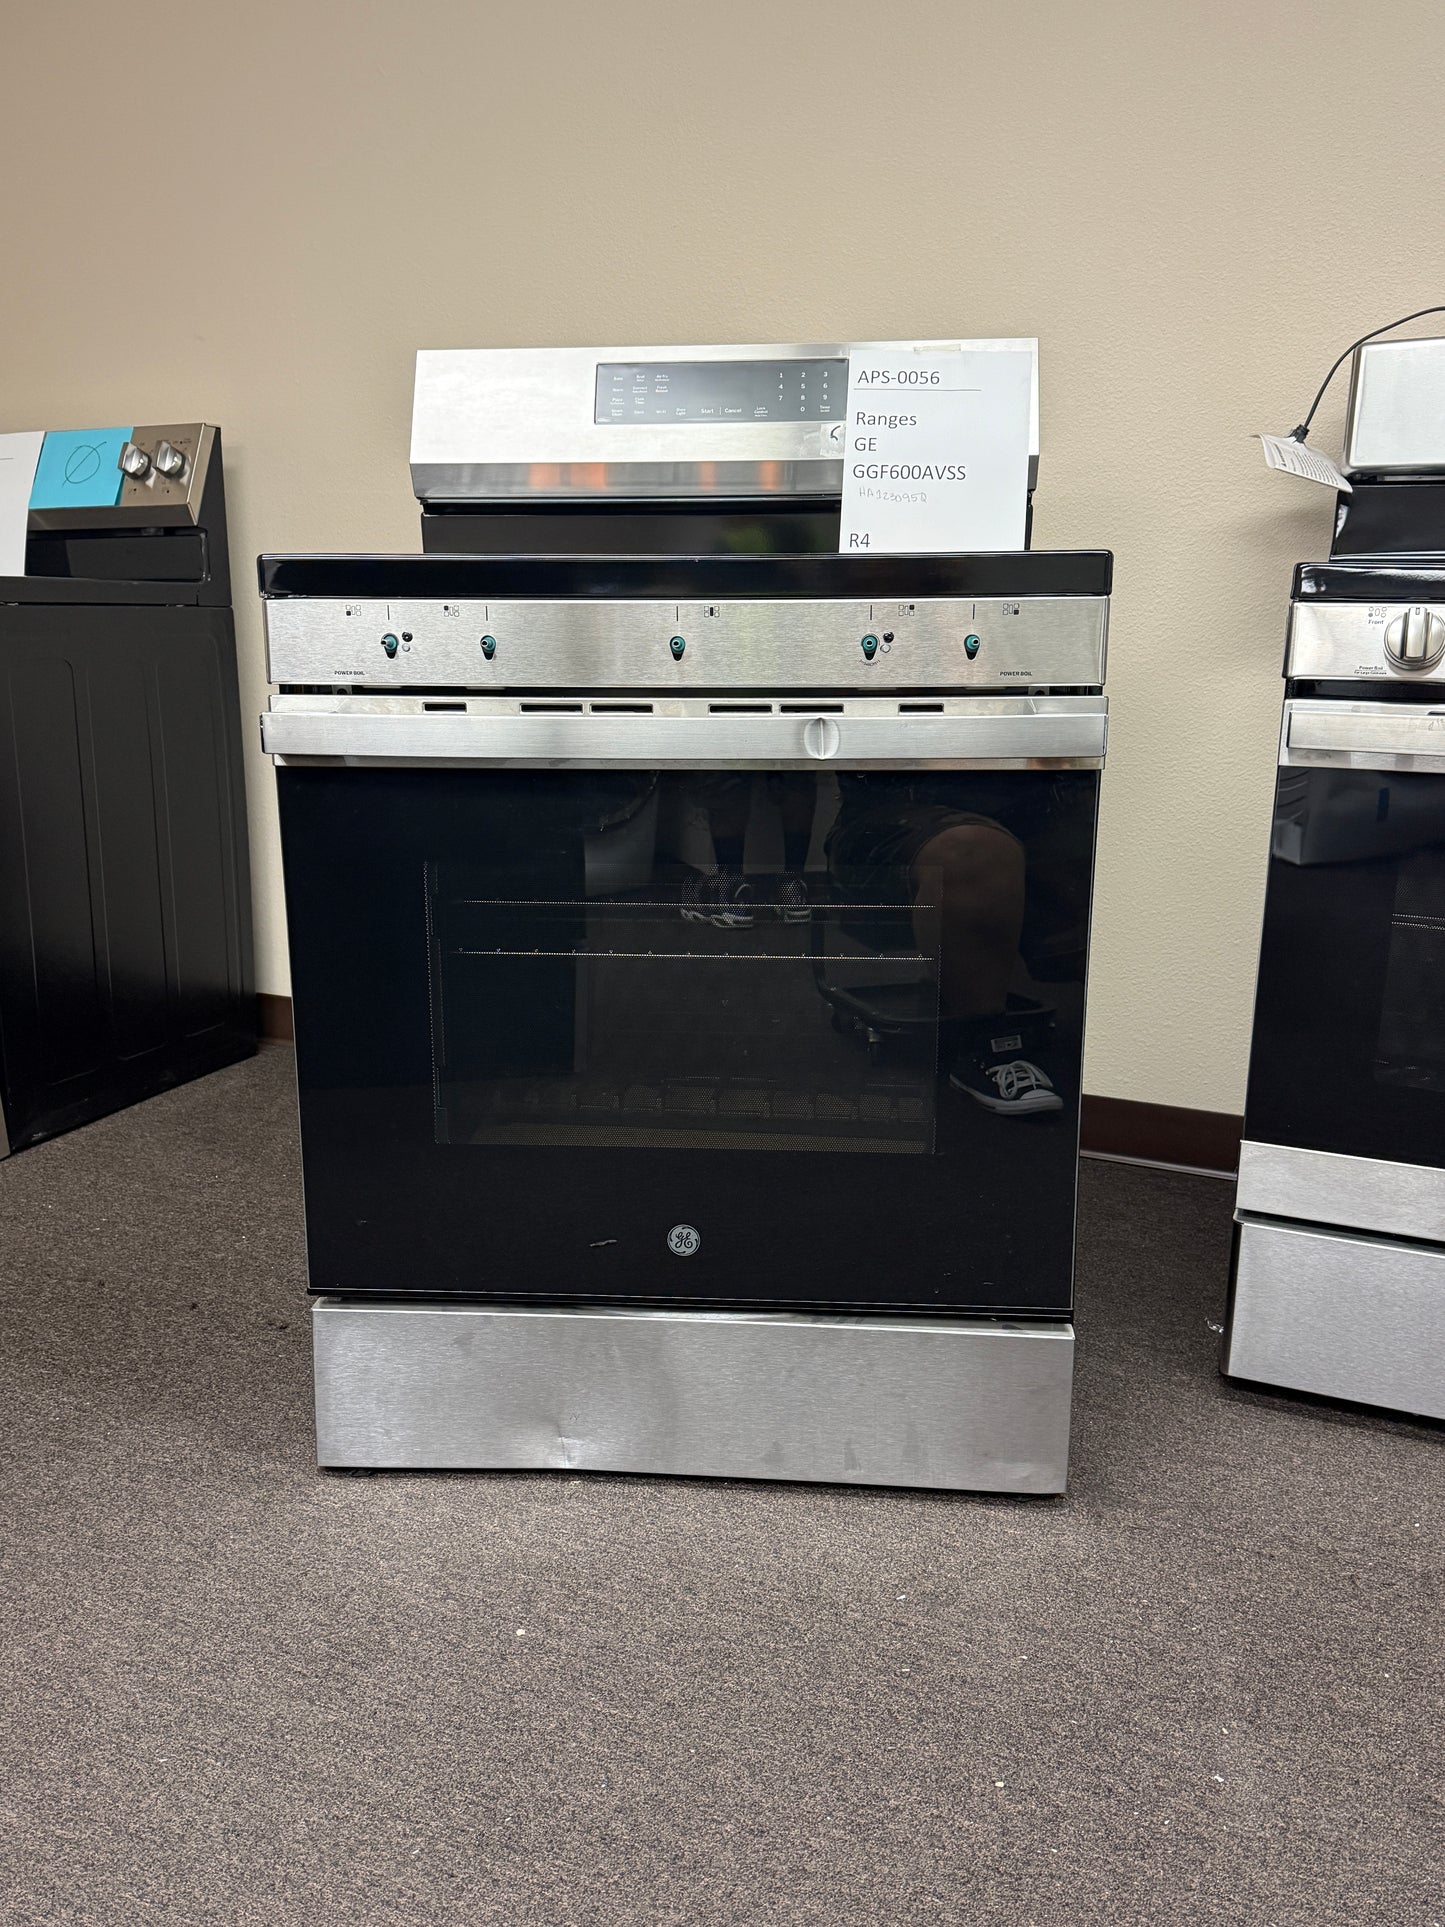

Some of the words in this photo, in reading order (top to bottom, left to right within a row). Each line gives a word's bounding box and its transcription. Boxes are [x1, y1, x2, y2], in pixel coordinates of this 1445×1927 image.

[857, 370, 940, 385] APS-0056
[856, 411, 917, 429] Ranges
[854, 437, 878, 451] GE
[852, 464, 967, 480] GGF600AVSS
[849, 533, 870, 548] R4
